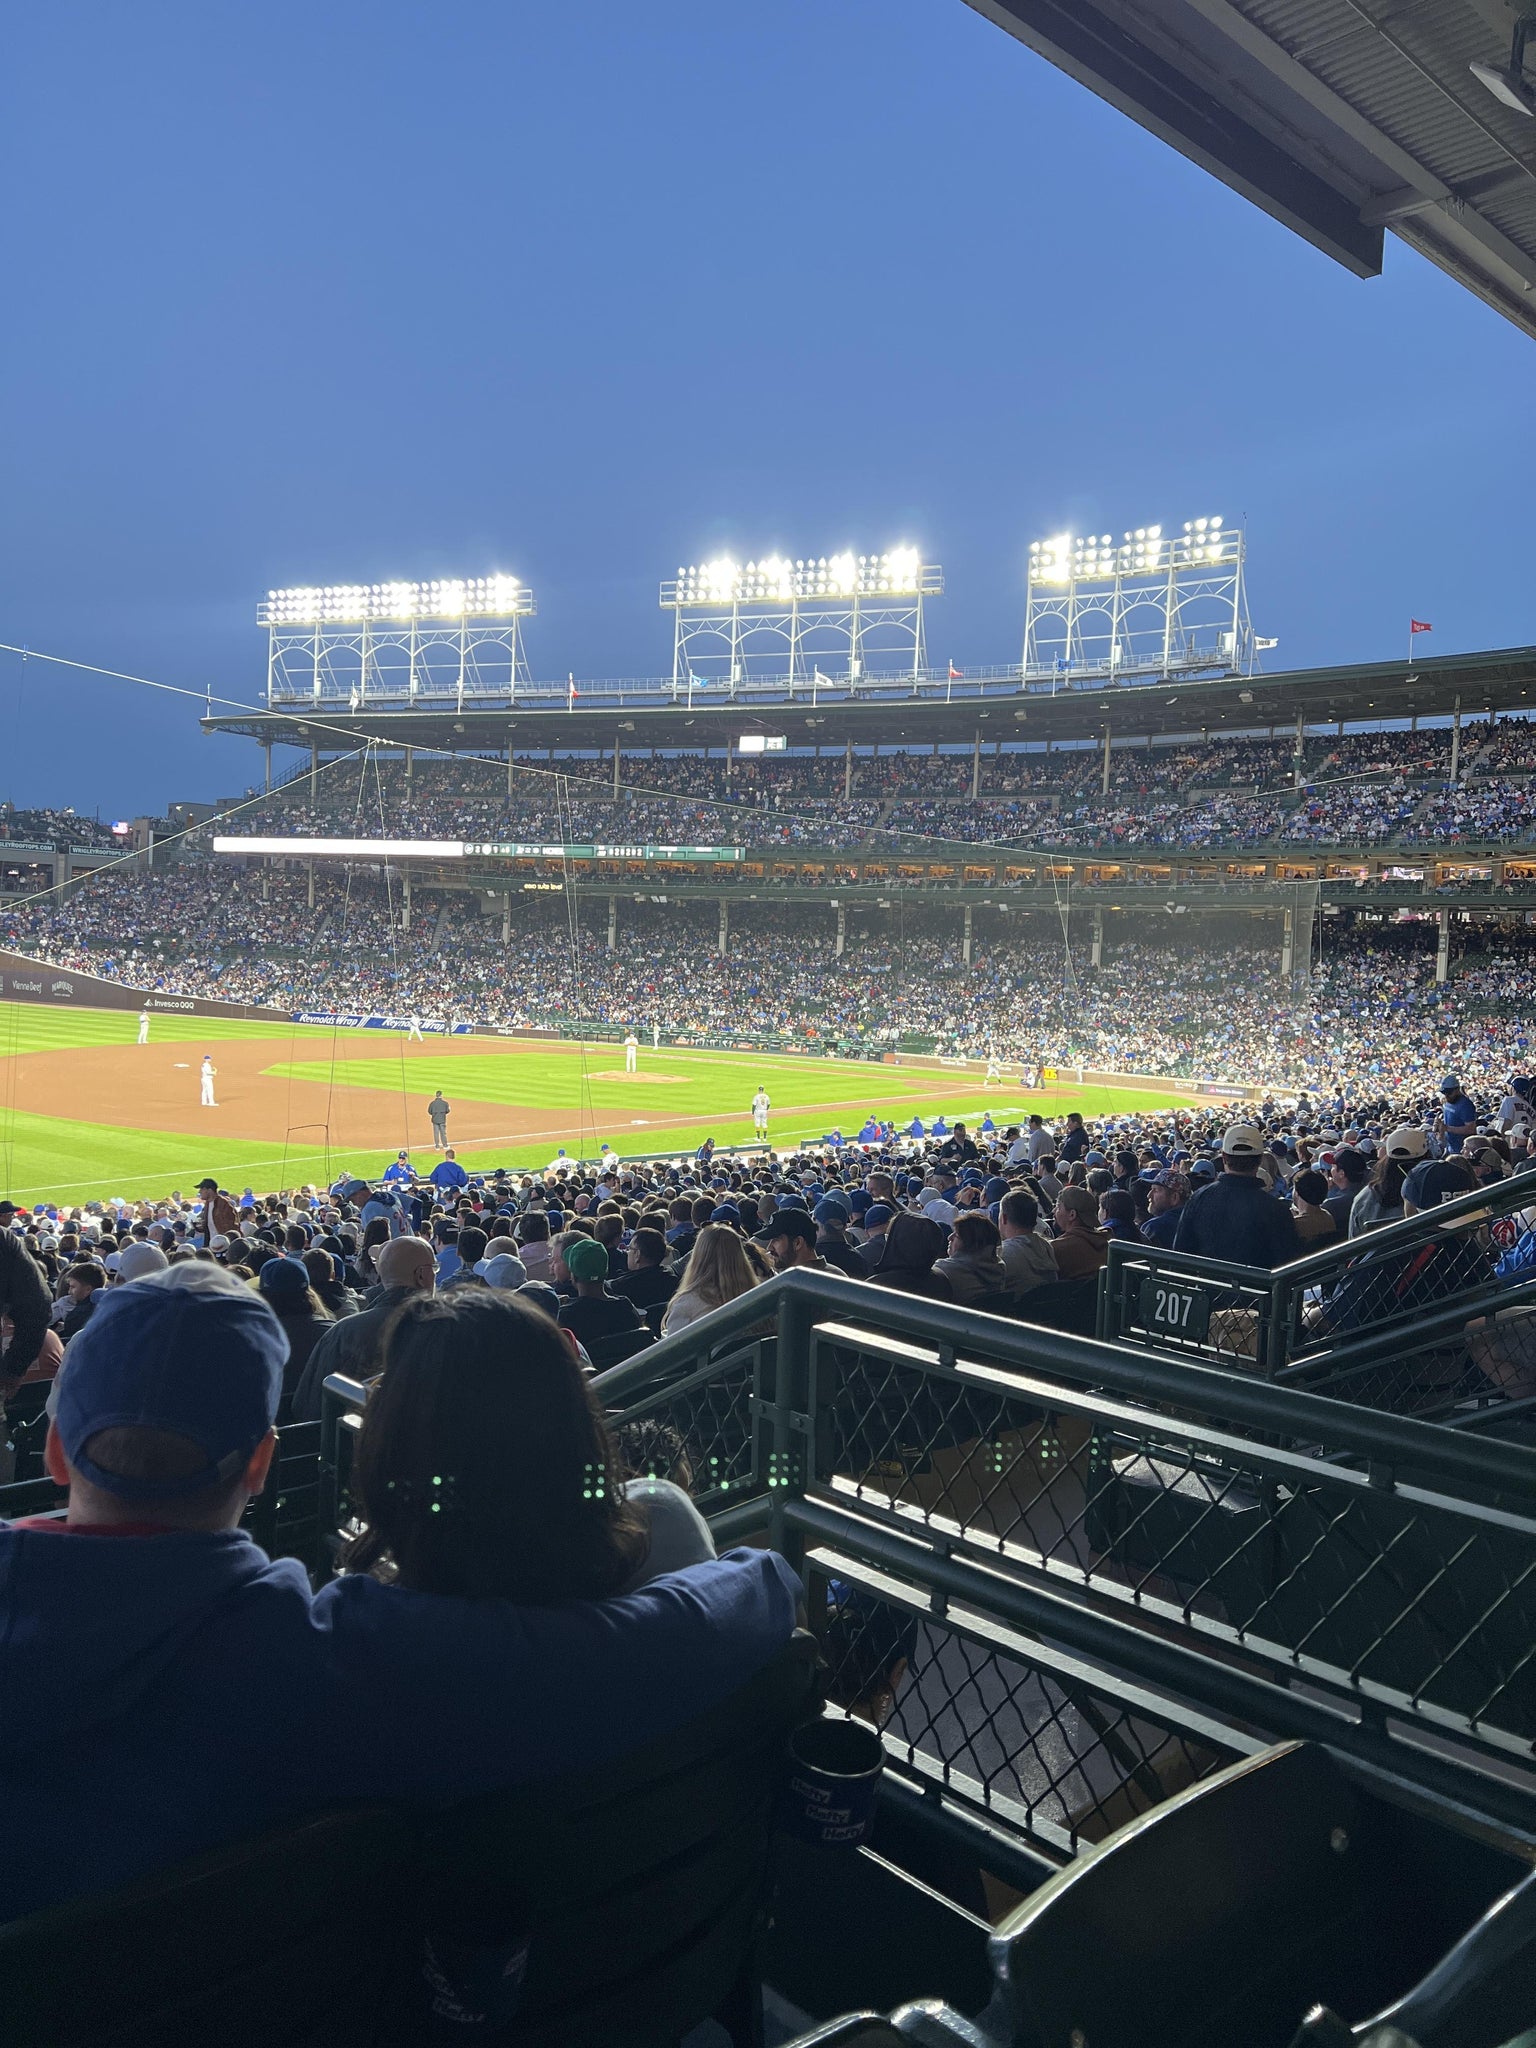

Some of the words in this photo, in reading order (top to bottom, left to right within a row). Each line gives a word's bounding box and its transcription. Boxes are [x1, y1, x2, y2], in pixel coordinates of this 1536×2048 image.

[12, 980, 29, 991] Vienna
[29, 981, 42, 994] Beef
[52, 980, 74, 994] MARQUEE
[154, 1000, 180, 1008] Invesco
[299, 1013, 335, 1025] Reynolds
[335, 1016, 359, 1027] Wrap
[422, 1020, 445, 1032] Wrap
[1154, 1289, 1193, 1327] 207
